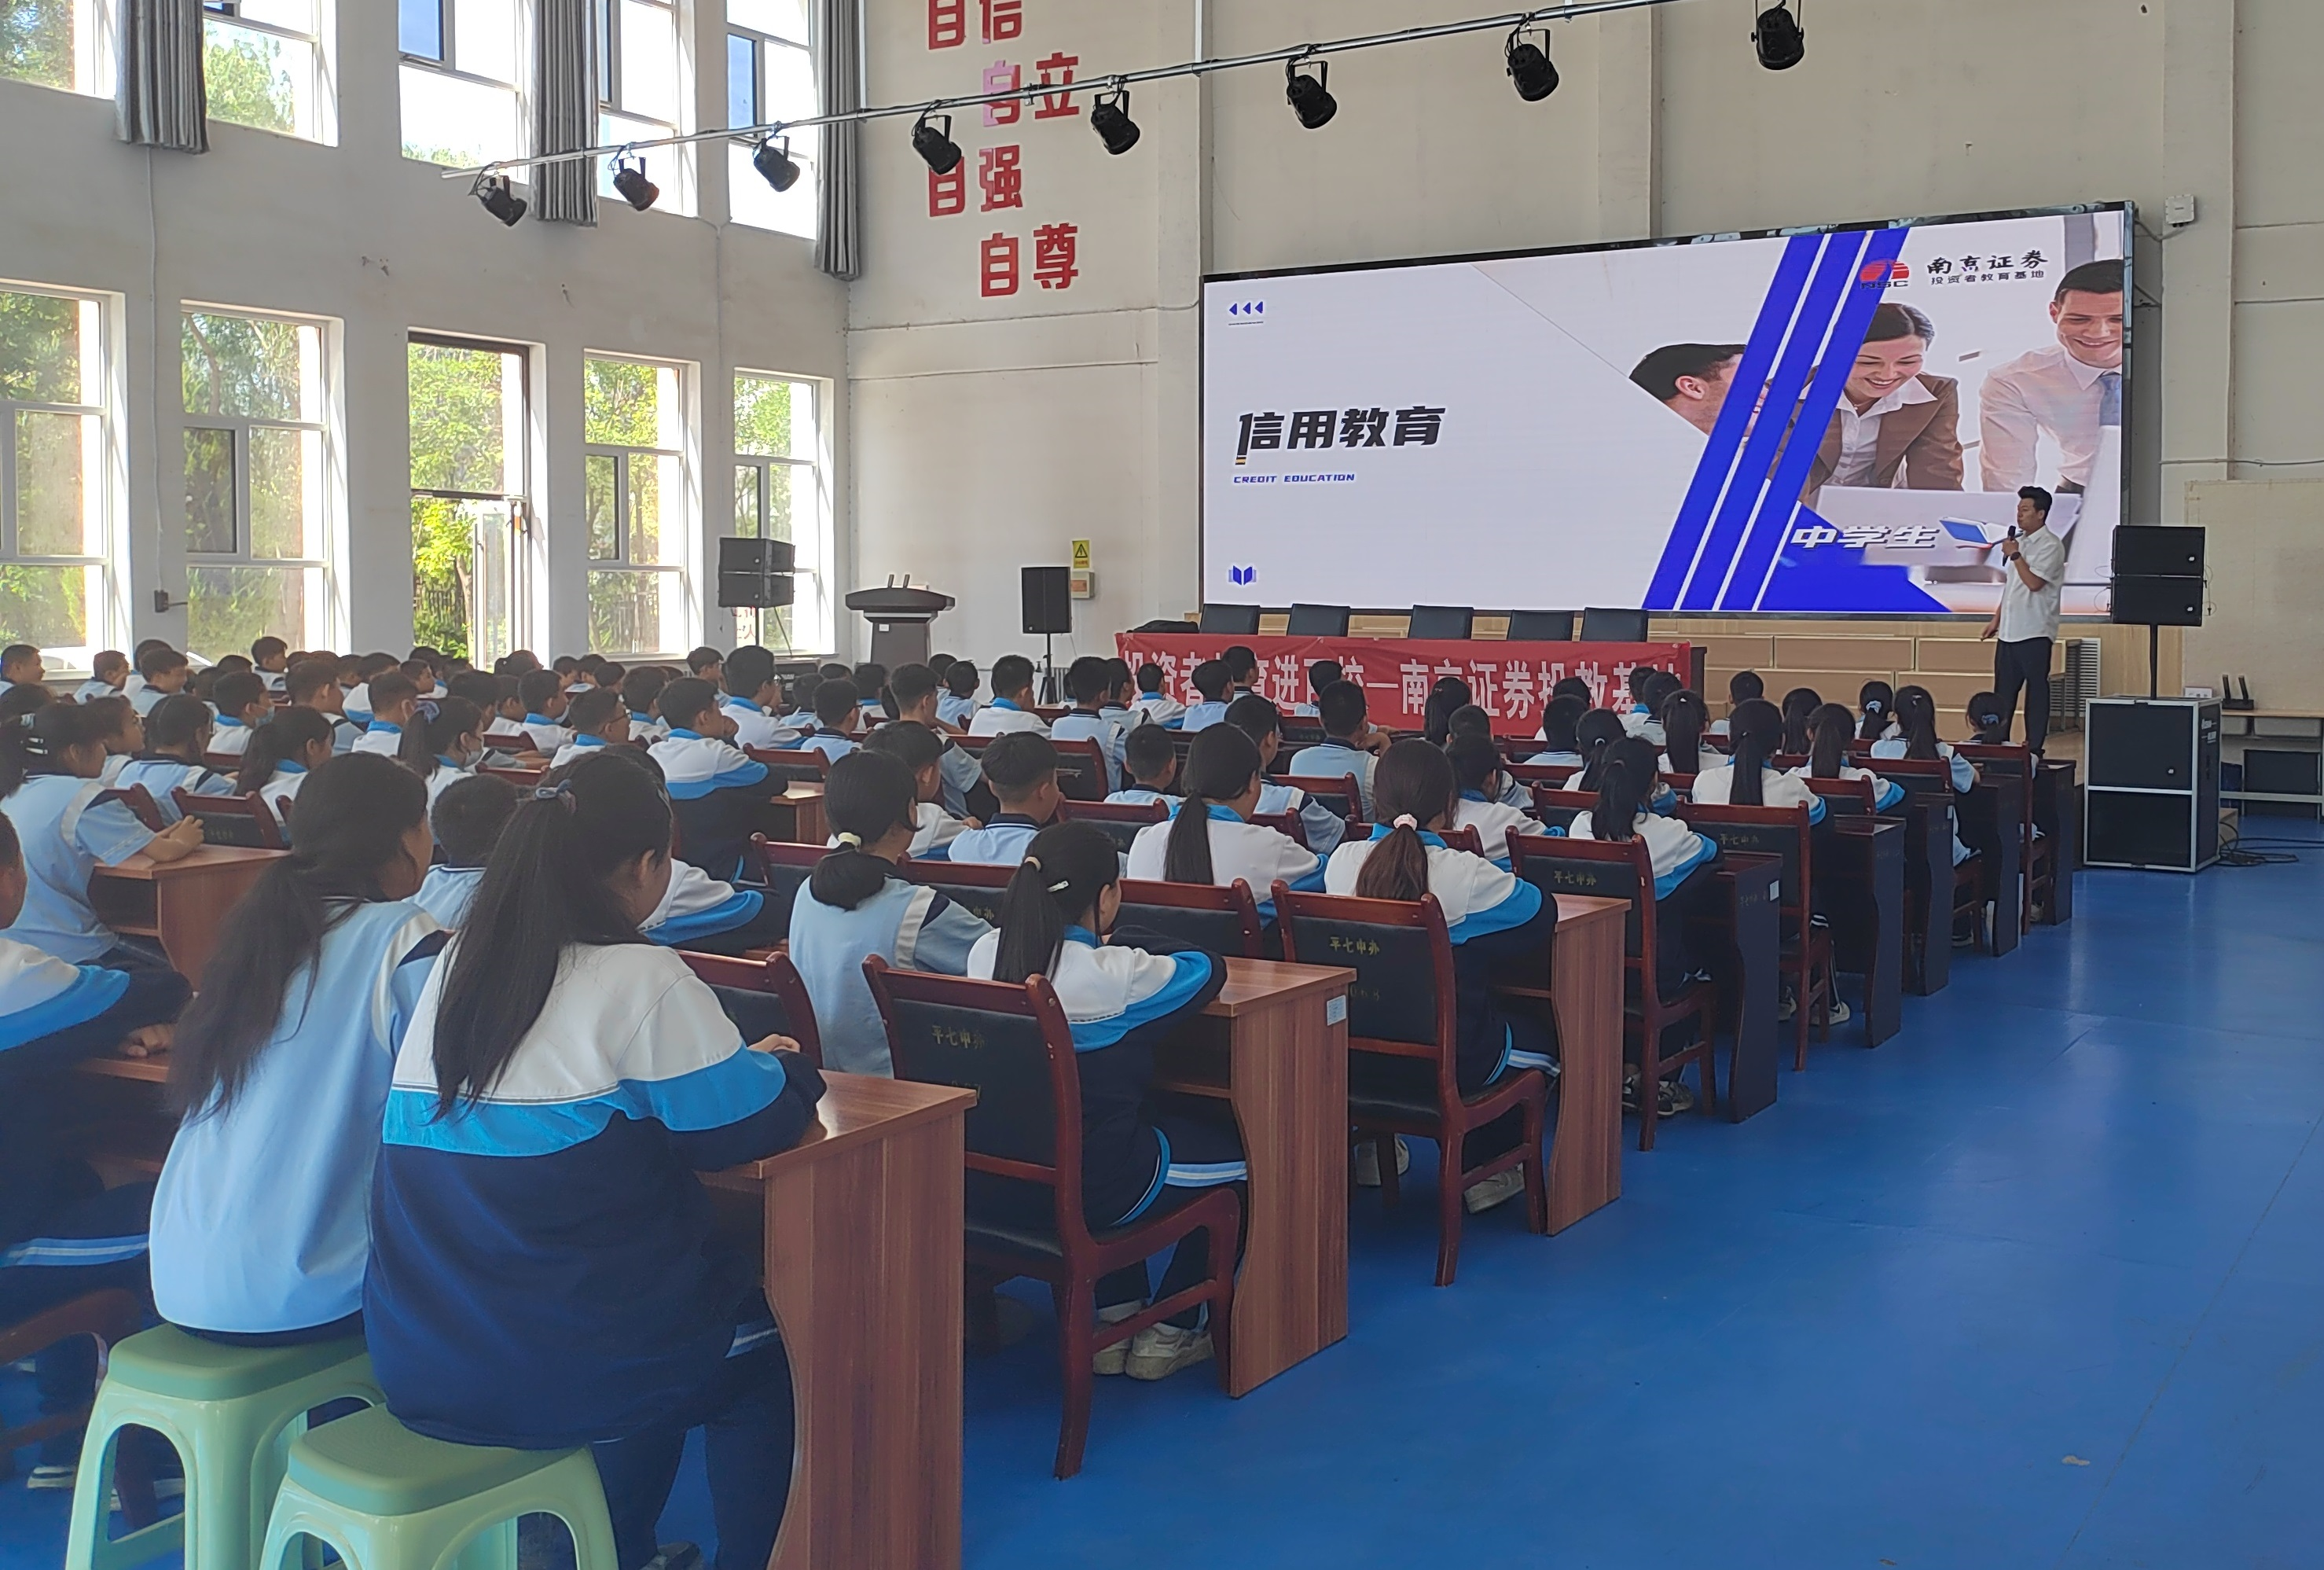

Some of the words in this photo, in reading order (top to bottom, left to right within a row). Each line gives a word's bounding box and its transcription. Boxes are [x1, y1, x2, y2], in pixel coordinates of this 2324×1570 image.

[928, 0, 1022, 50] 自信
[982, 52, 1080, 127] 自立
[928, 145, 1023, 217] 自强
[981, 222, 1078, 297] 自尊
[1927, 249, 2049, 274] 南京证券
[1931, 270, 2044, 285] 投资者教育基地
[1860, 280, 1908, 289] NSC
[1235, 406, 1446, 465] 信用教育
[1233, 475, 1277, 484] CREDIT
[1284, 473, 1355, 483] EDUCATION
[1790, 525, 1940, 549] 中学生
